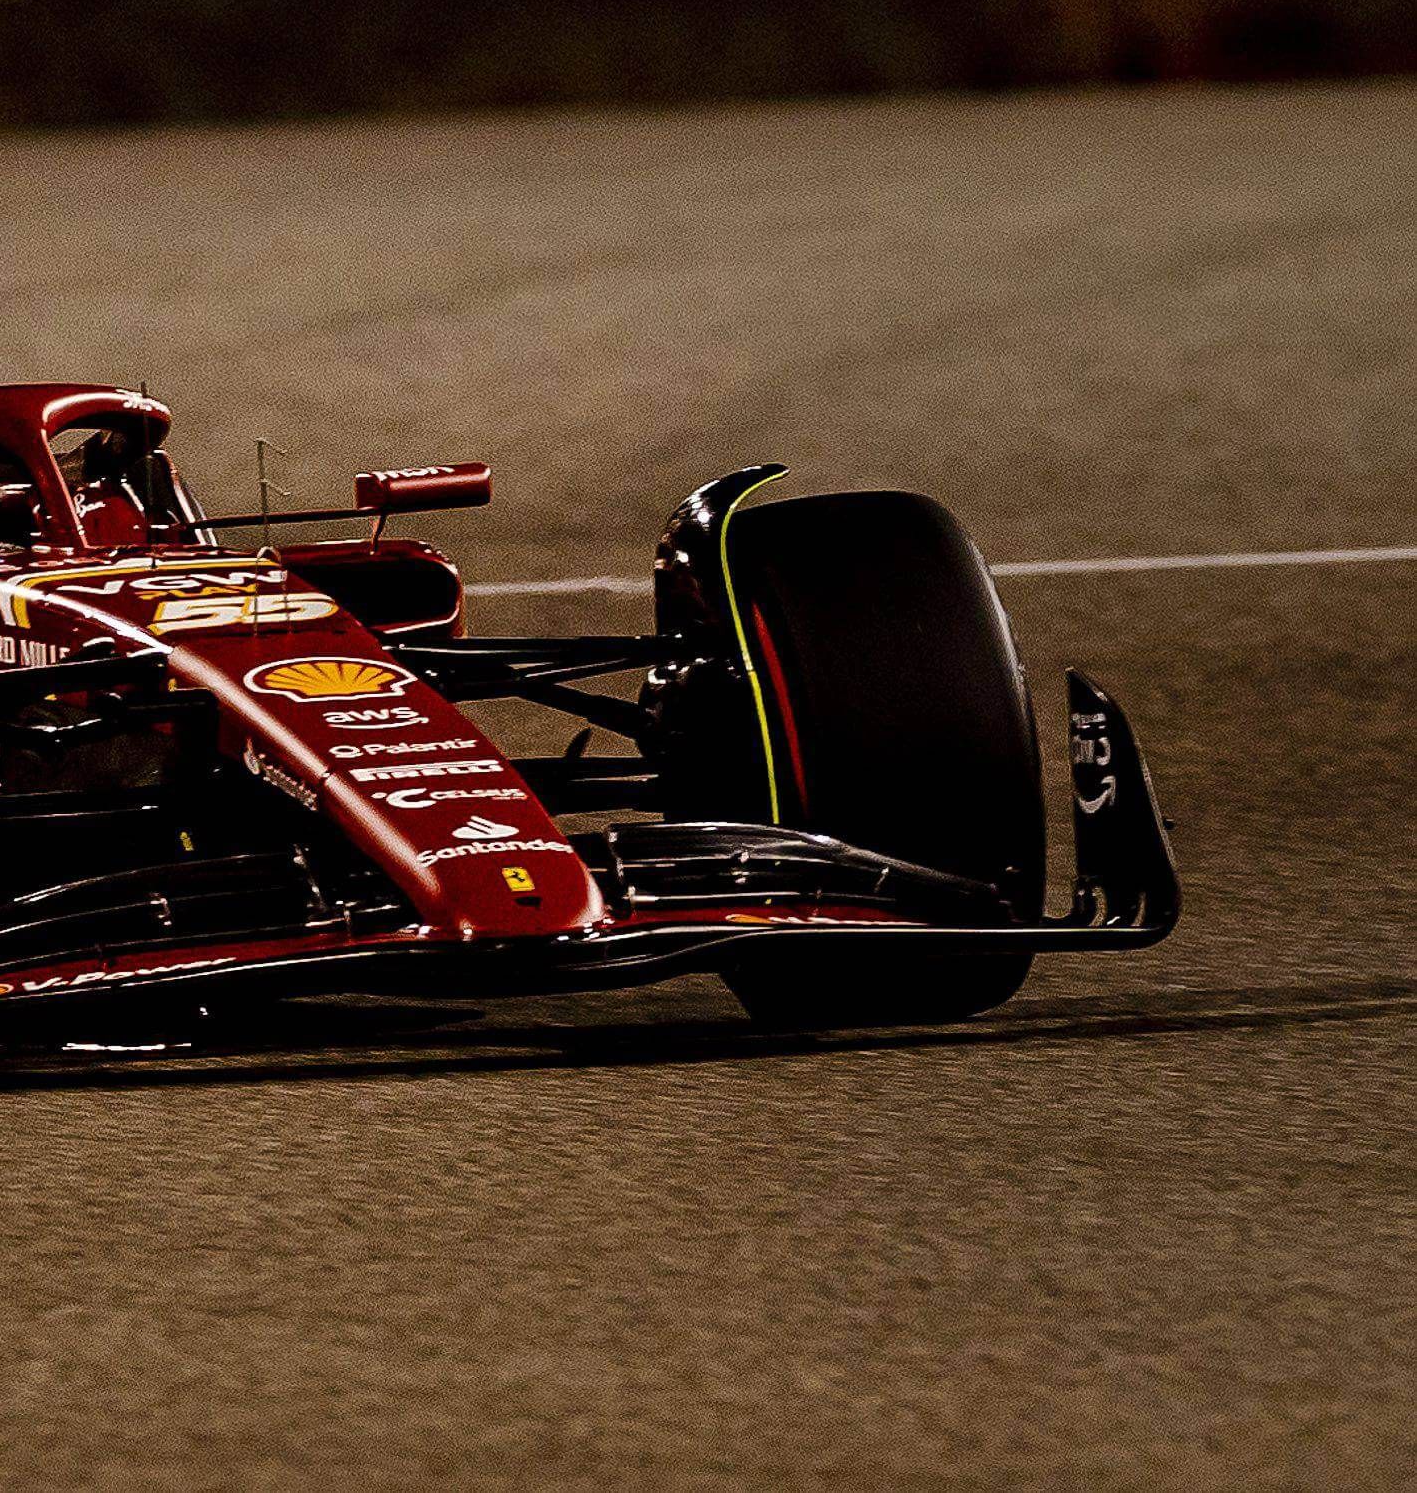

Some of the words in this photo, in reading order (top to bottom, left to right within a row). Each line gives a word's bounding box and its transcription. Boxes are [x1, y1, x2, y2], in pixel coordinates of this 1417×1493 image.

[56, 570, 288, 595] VGW
[146, 592, 341, 635] 55
[322, 706, 423, 725] aws
[362, 738, 478, 756] Palantir
[349, 759, 504, 782] PIRELLI
[415, 838, 574, 869] Santander
